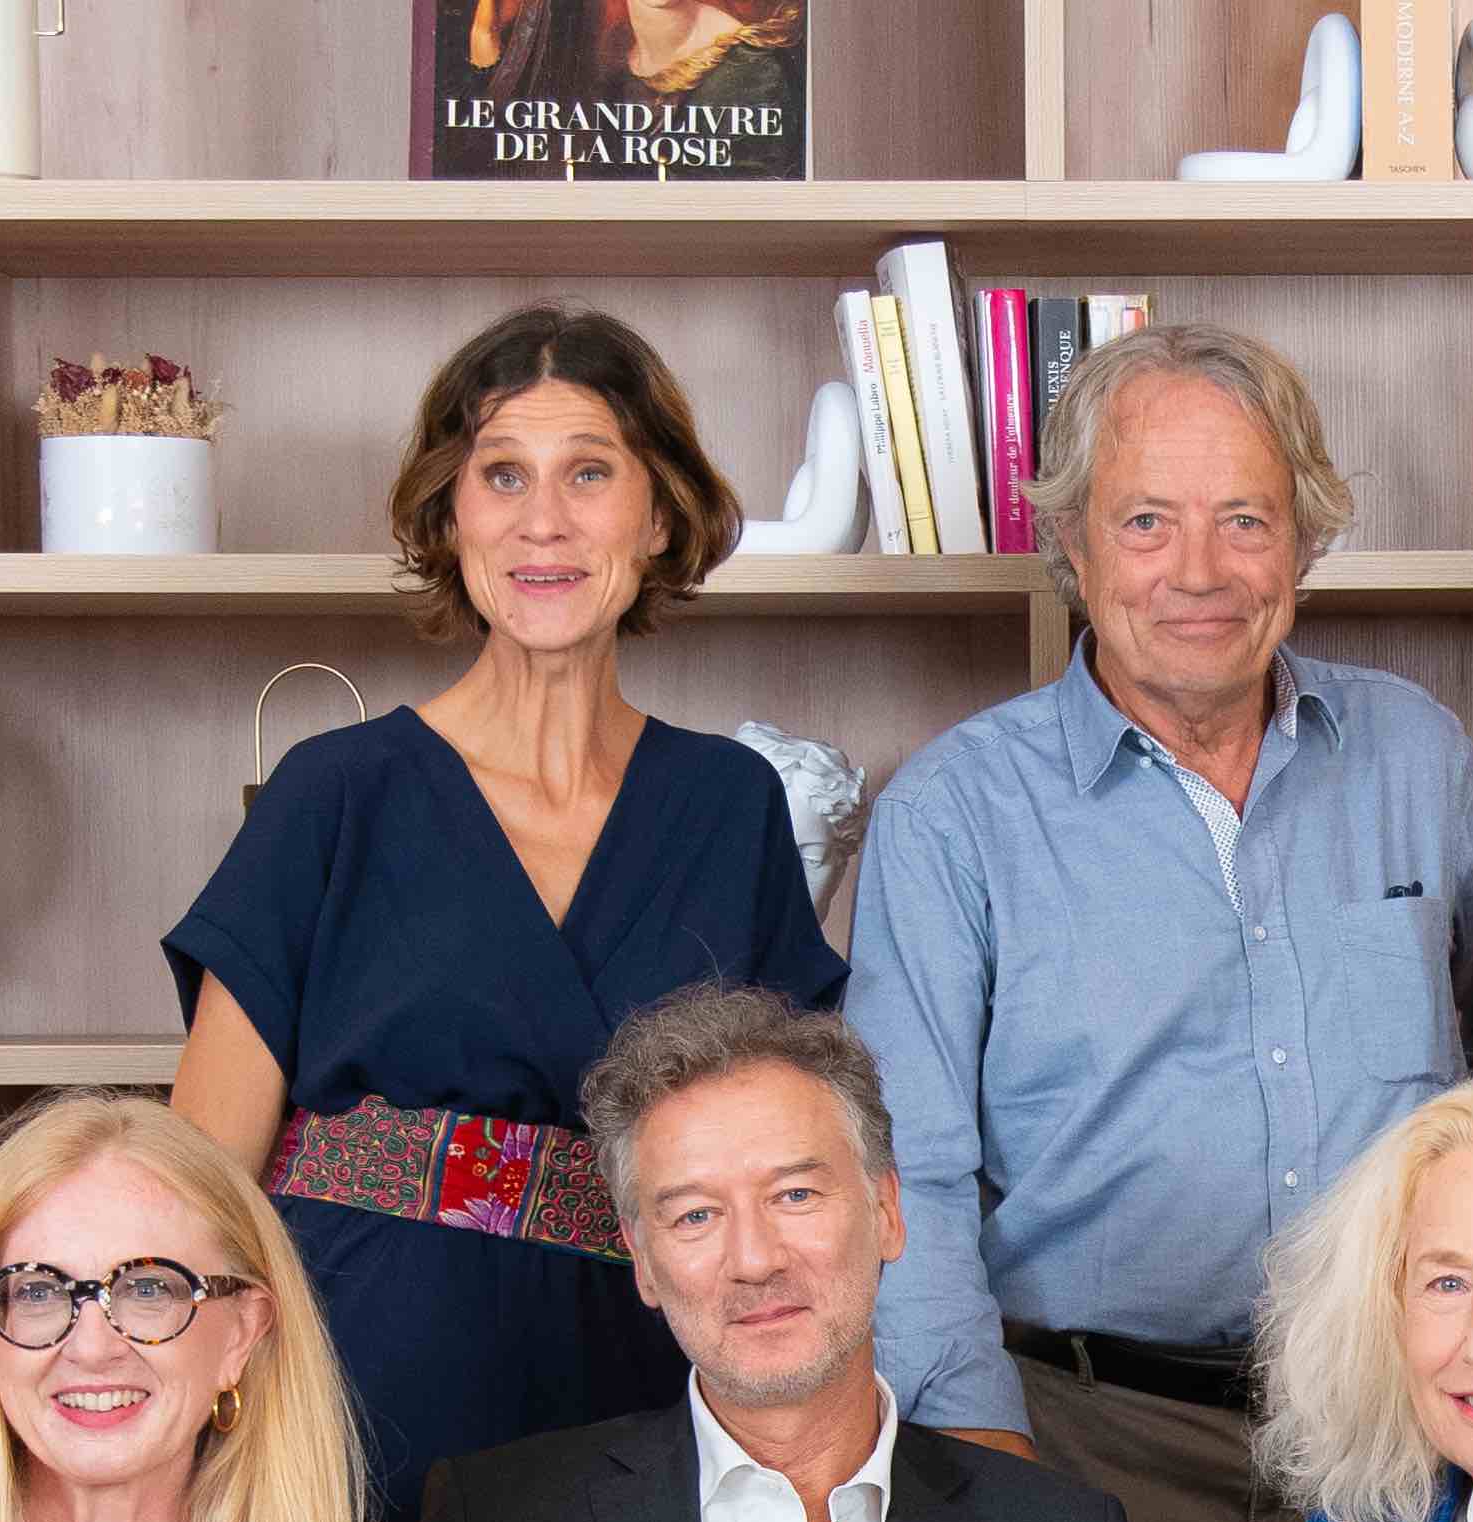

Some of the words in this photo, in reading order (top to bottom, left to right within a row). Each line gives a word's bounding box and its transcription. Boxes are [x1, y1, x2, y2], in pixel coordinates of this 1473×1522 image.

[1396, 1, 1416, 105] MODERNE
[445, 99, 495, 128] LE
[503, 100, 654, 133] GRAND
[663, 105, 783, 137] LIVRE
[1396, 110, 1416, 145] A-Z
[494, 132, 549, 162] DE
[560, 133, 614, 164] LA
[622, 135, 732, 167] ROSE
[1388, 165, 1427, 174] TASCHEN
[857, 319, 877, 375] Manuella
[869, 382, 882, 412] Labro
[872, 413, 887, 455] Philippe
[1007, 446, 1018, 460] de
[1007, 462, 1020, 505] douleur
